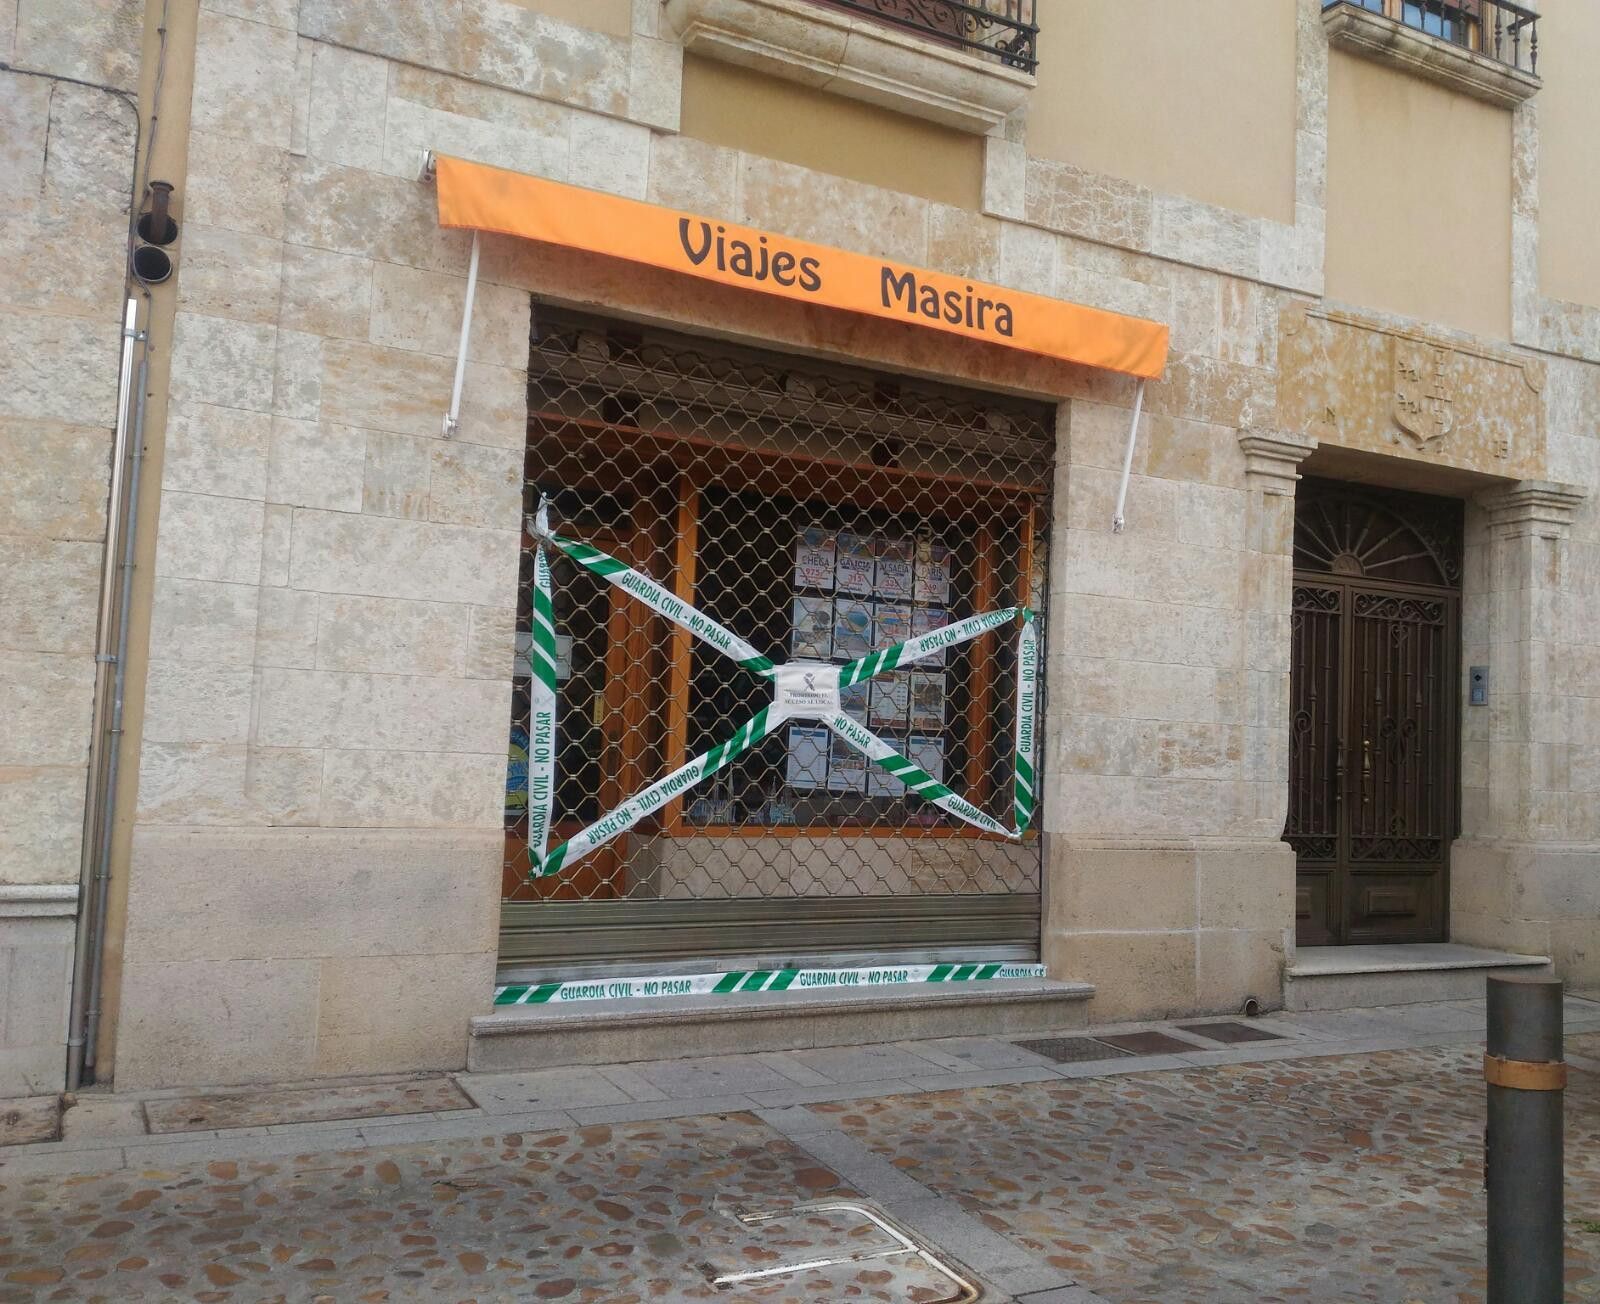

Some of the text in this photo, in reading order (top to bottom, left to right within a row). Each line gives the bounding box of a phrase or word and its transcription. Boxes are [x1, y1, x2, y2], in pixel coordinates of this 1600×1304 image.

[679, 218, 1013, 337] Viajes Masira
[621, 572, 661, 606] GUARDIA
[661, 597, 683, 619] CIVIL
[688, 614, 704, 631] NO
[703, 624, 732, 650] PASAR
[944, 628, 957, 641] NO
[962, 620, 981, 636] CIVIL
[918, 635, 943, 652] PASAR
[1023, 639, 1036, 666] PASAR
[1023, 668, 1035, 682] NO
[1022, 690, 1034, 712] CIVIL
[535, 711, 552, 746] PASAR
[846, 724, 871, 748] PASAR
[1020, 715, 1033, 752] GUARDIA
[534, 749, 550, 764] NO
[533, 774, 549, 801] CIVIL
[660, 765, 700, 796] GUARDIA
[636, 790, 661, 811] CIVIL
[947, 796, 980, 821] GUARDIA
[616, 807, 633, 825] NO
[586, 817, 618, 844] PASAR
[800, 971, 837, 986] GUARDIA
[839, 970, 860, 985] CIVIL
[868, 970, 881, 984] NO
[883, 969, 908, 983] PASAR
[560, 983, 605, 1000] GUARDIA
[608, 983, 633, 998] CIVIL
[644, 981, 658, 995] NO
[661, 980, 692, 994] PASAR
